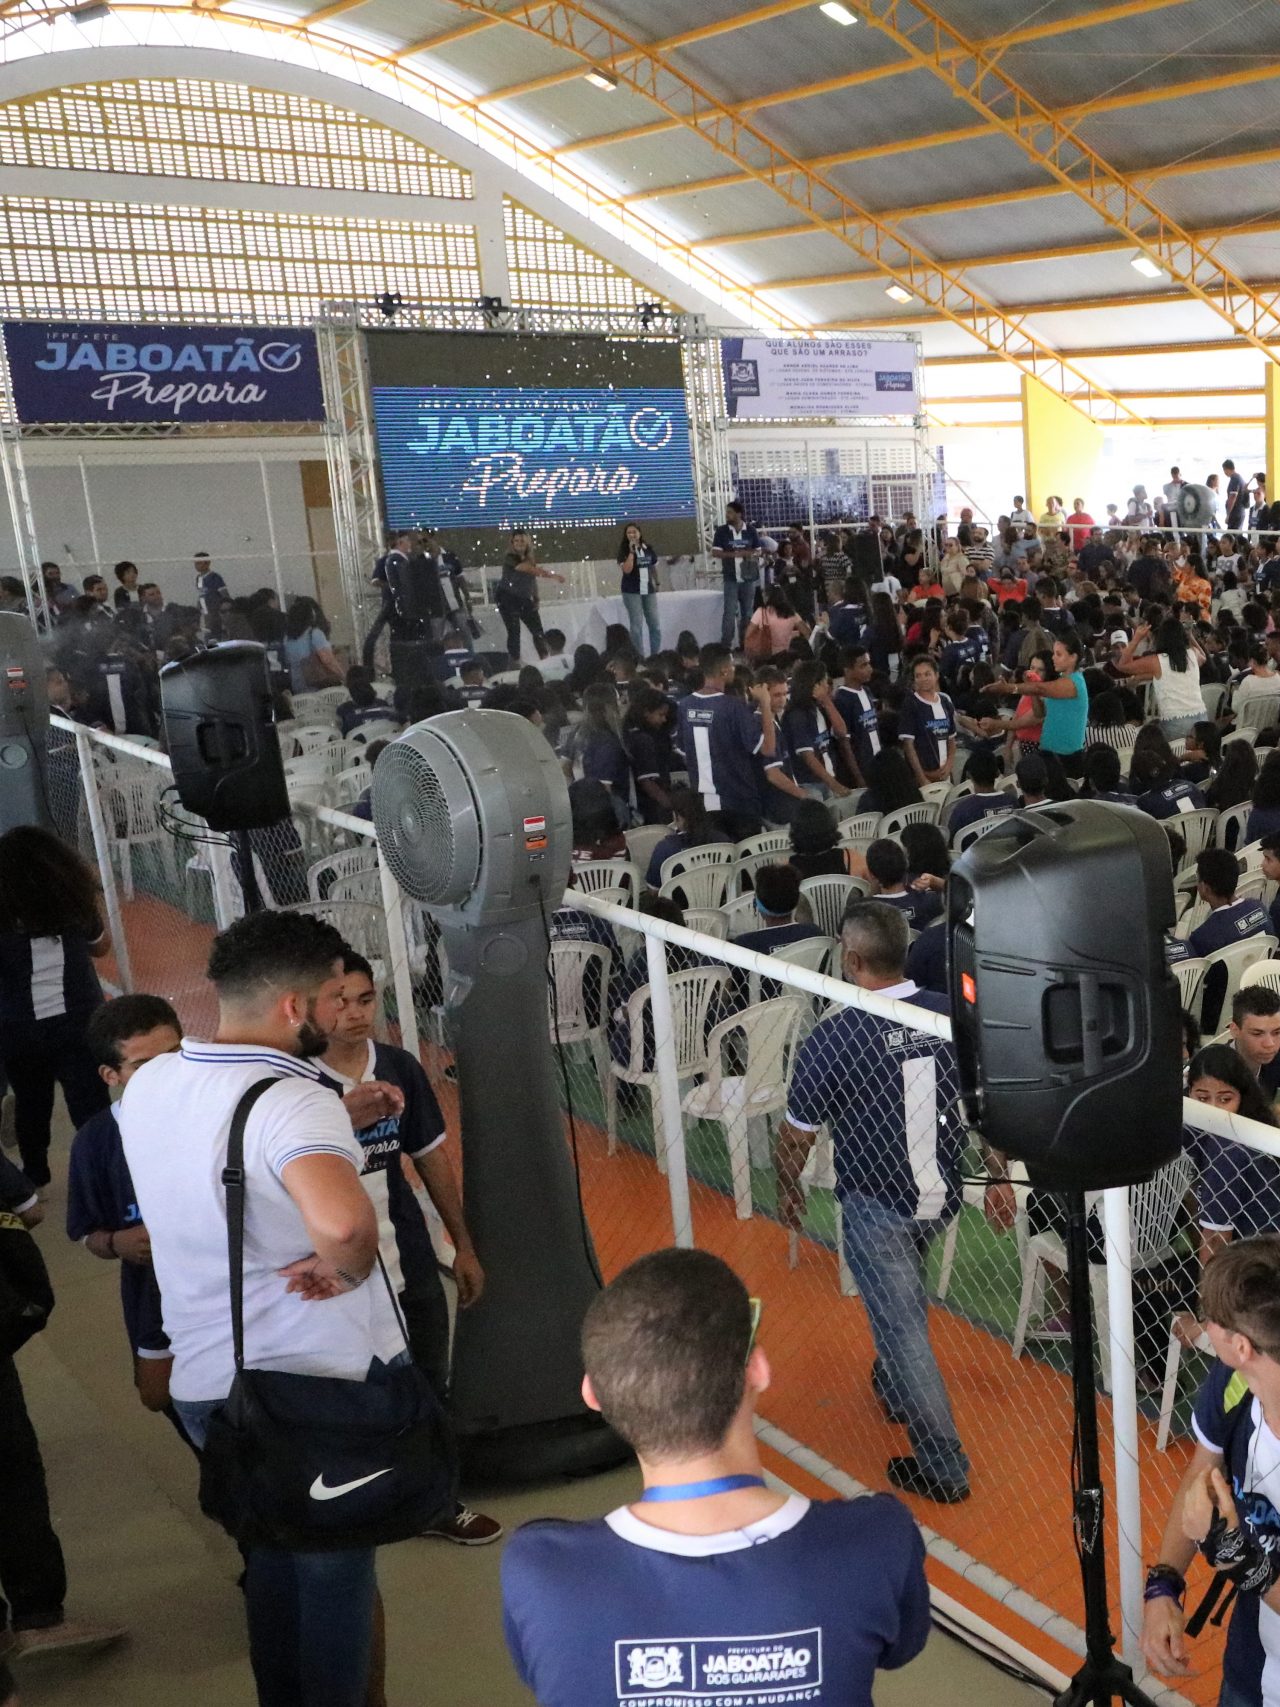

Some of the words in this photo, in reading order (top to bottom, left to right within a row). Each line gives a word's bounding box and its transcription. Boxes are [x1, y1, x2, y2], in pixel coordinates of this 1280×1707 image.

[771, 348, 789, 356] QUE
[91, 371, 267, 415] Prepara
[461, 453, 639, 509] Prepara
[703, 1647, 812, 1674] JABOATÃO
[706, 1672, 731, 1686] DOS
[732, 1667, 807, 1685] GUARARAPES
[620, 1697, 713, 1707] COMPROMISSO
[715, 1697, 744, 1707] COM
[747, 1696, 755, 1706] A
[758, 1688, 822, 1704] MUDANÇA
